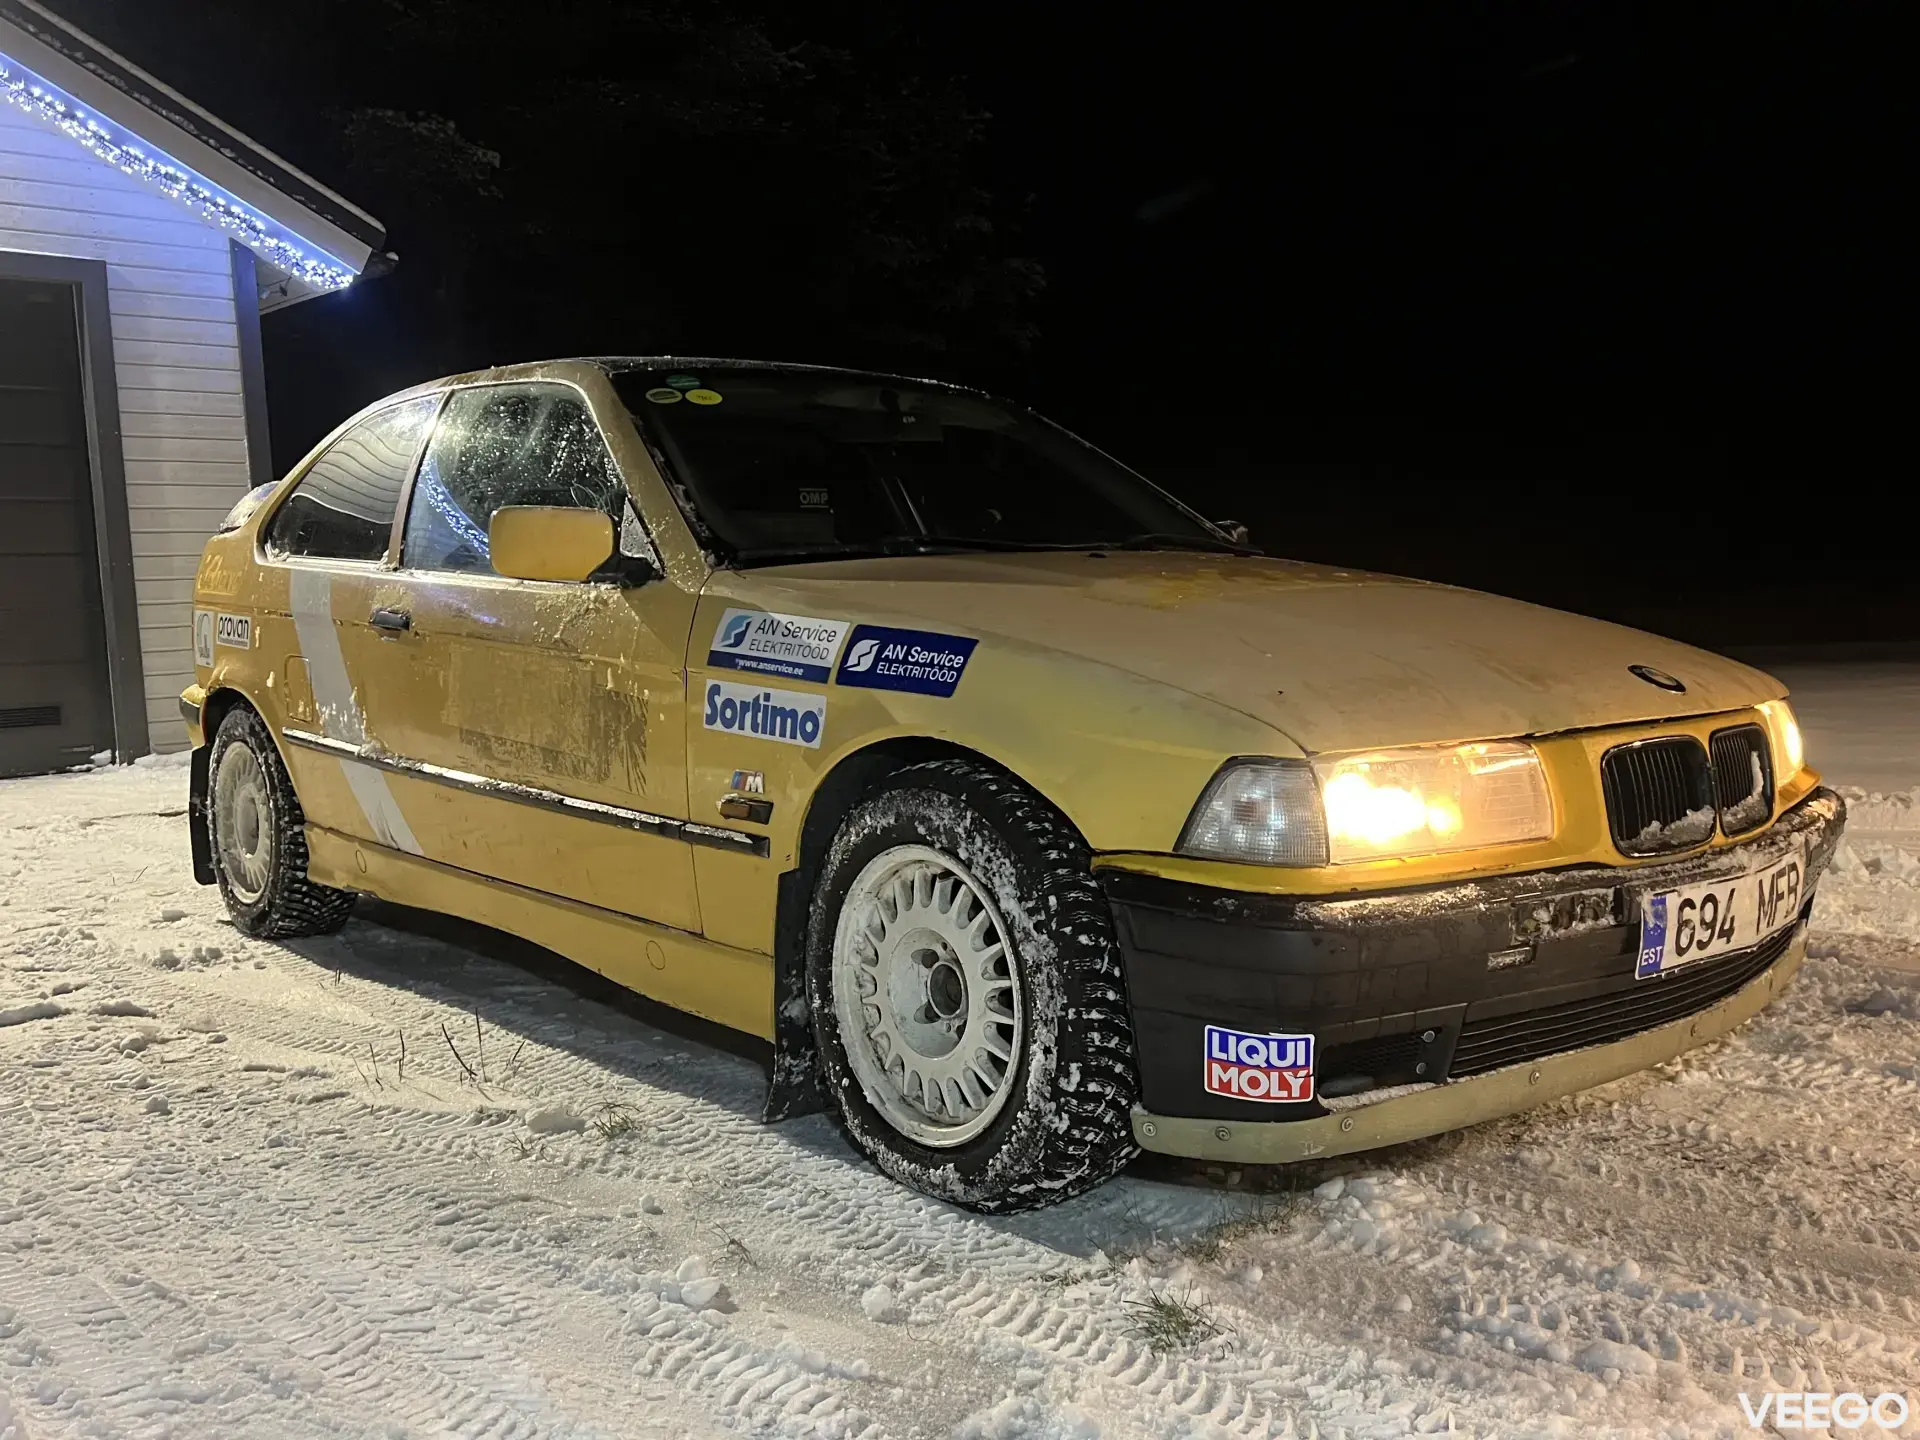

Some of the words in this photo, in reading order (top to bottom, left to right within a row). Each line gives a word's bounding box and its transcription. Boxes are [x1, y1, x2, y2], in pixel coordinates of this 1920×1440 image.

[799, 491, 829, 505] OMP
[754, 618, 780, 636] AN
[781, 621, 837, 643] Service
[738, 657, 804, 676] www.anservice.ee
[881, 643, 907, 660] AN
[908, 646, 964, 668] Service
[705, 683, 820, 744] Sortimo
[1674, 887, 1736, 957] 694
[1756, 861, 1800, 935] MFB
[1640, 945, 1663, 967] EST
[1211, 1031, 1306, 1068] LIQUI
[1211, 1062, 1308, 1097] MOLY
